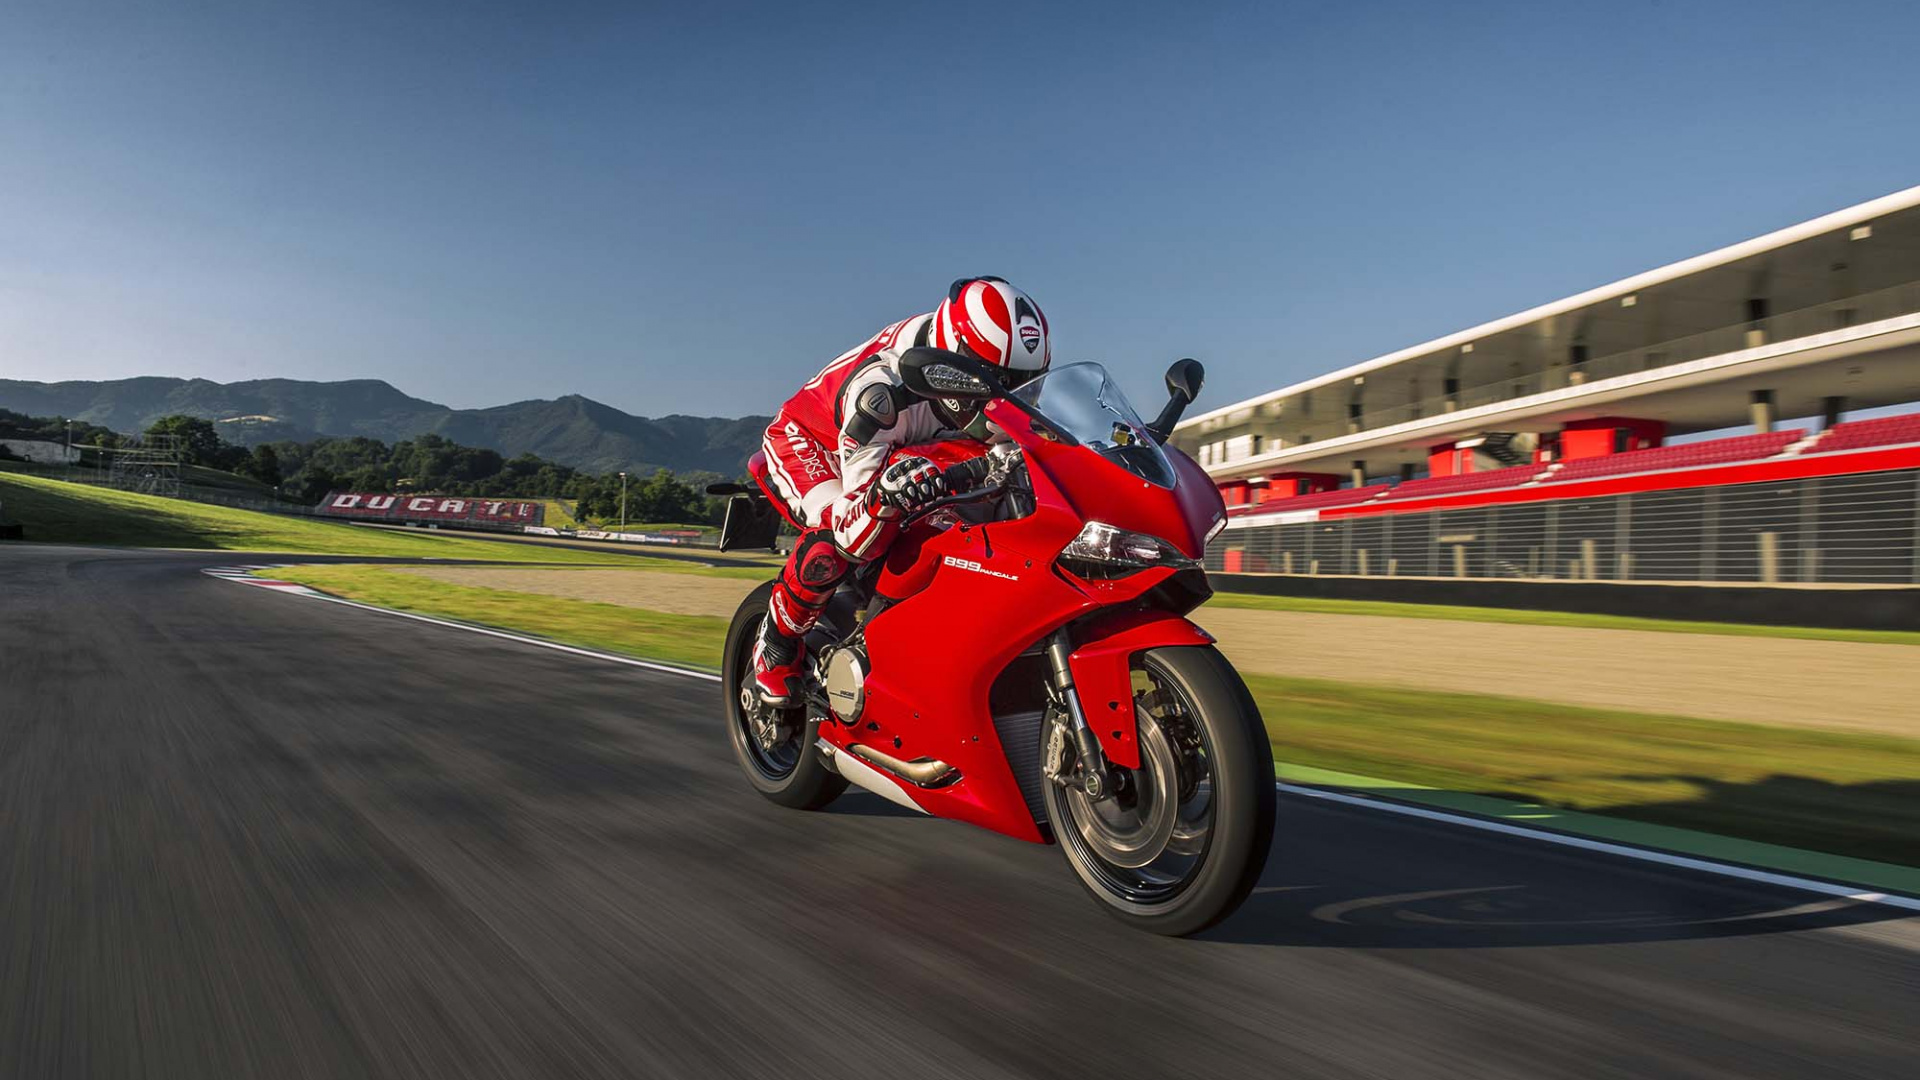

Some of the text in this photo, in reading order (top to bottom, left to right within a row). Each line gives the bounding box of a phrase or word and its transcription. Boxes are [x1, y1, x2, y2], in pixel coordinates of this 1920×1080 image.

[332, 494, 528, 516] DUCATI
[944, 556, 1019, 581] 899 PANIGALE
